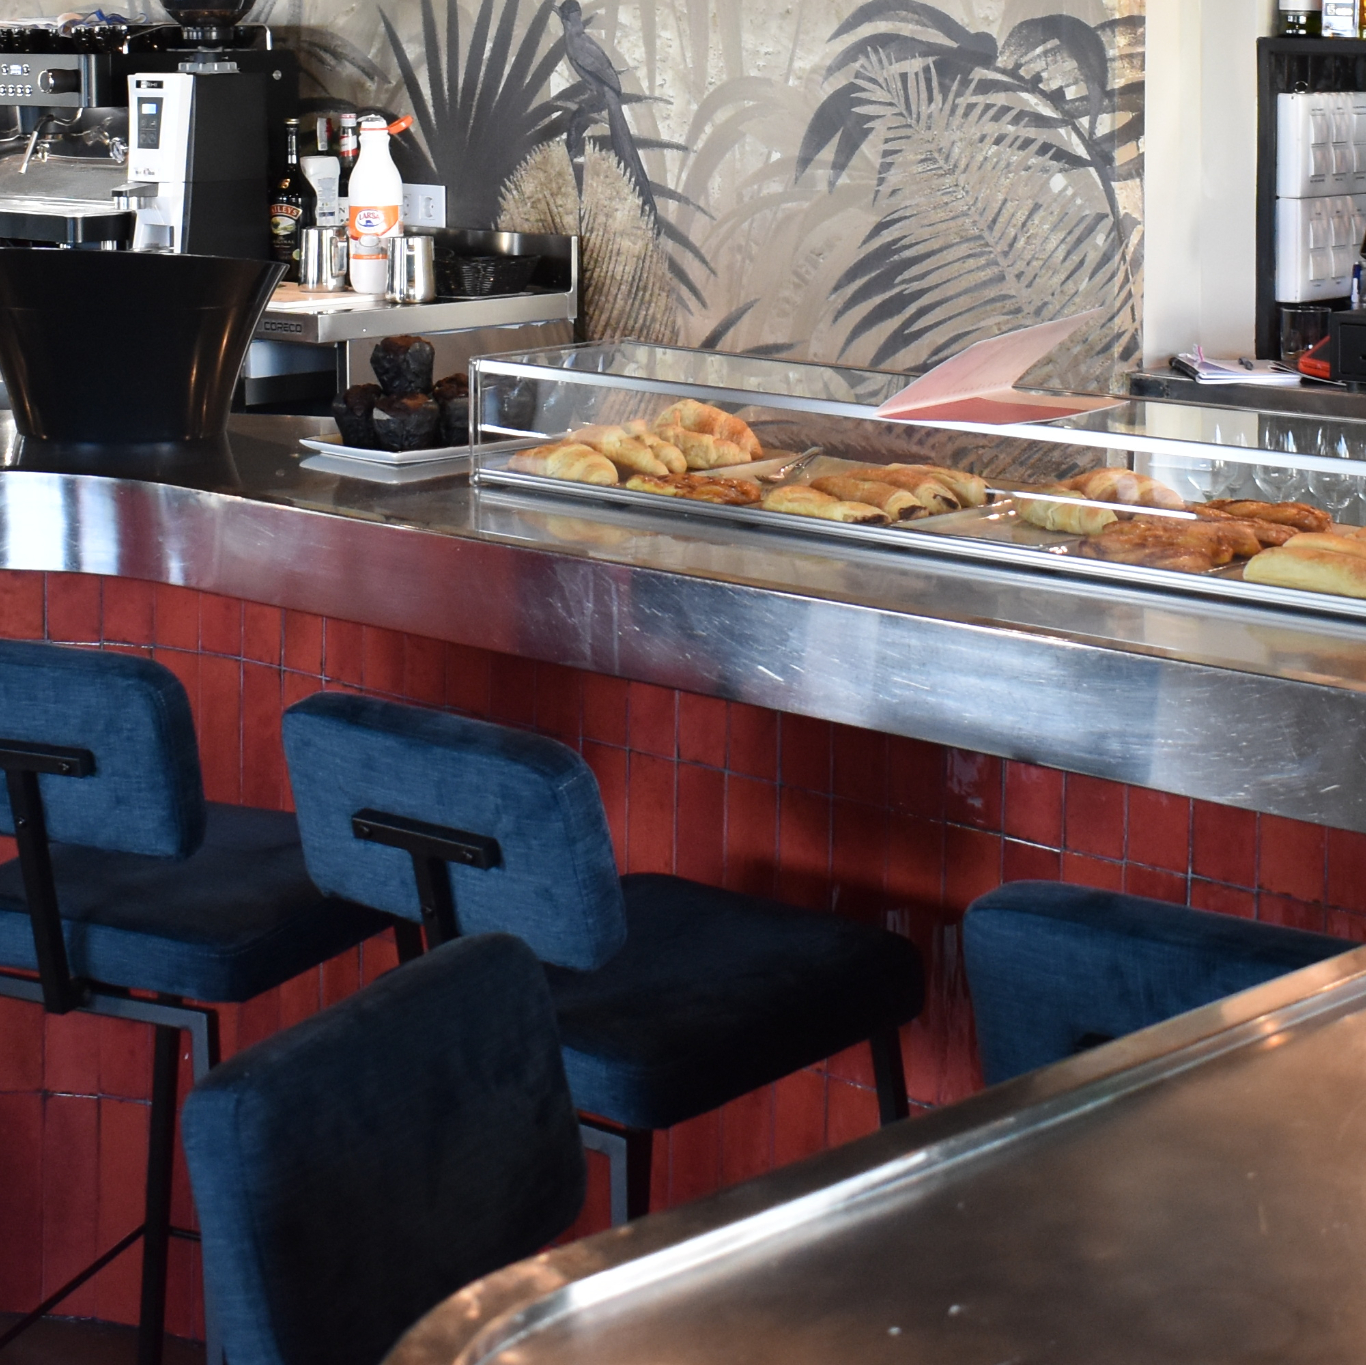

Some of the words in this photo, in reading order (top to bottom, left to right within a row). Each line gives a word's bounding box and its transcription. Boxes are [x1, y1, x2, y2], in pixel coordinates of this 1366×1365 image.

[271, 205, 298, 216] AILEYS
[358, 211, 381, 220] LARSA
[263, 321, 303, 333] CORECO
